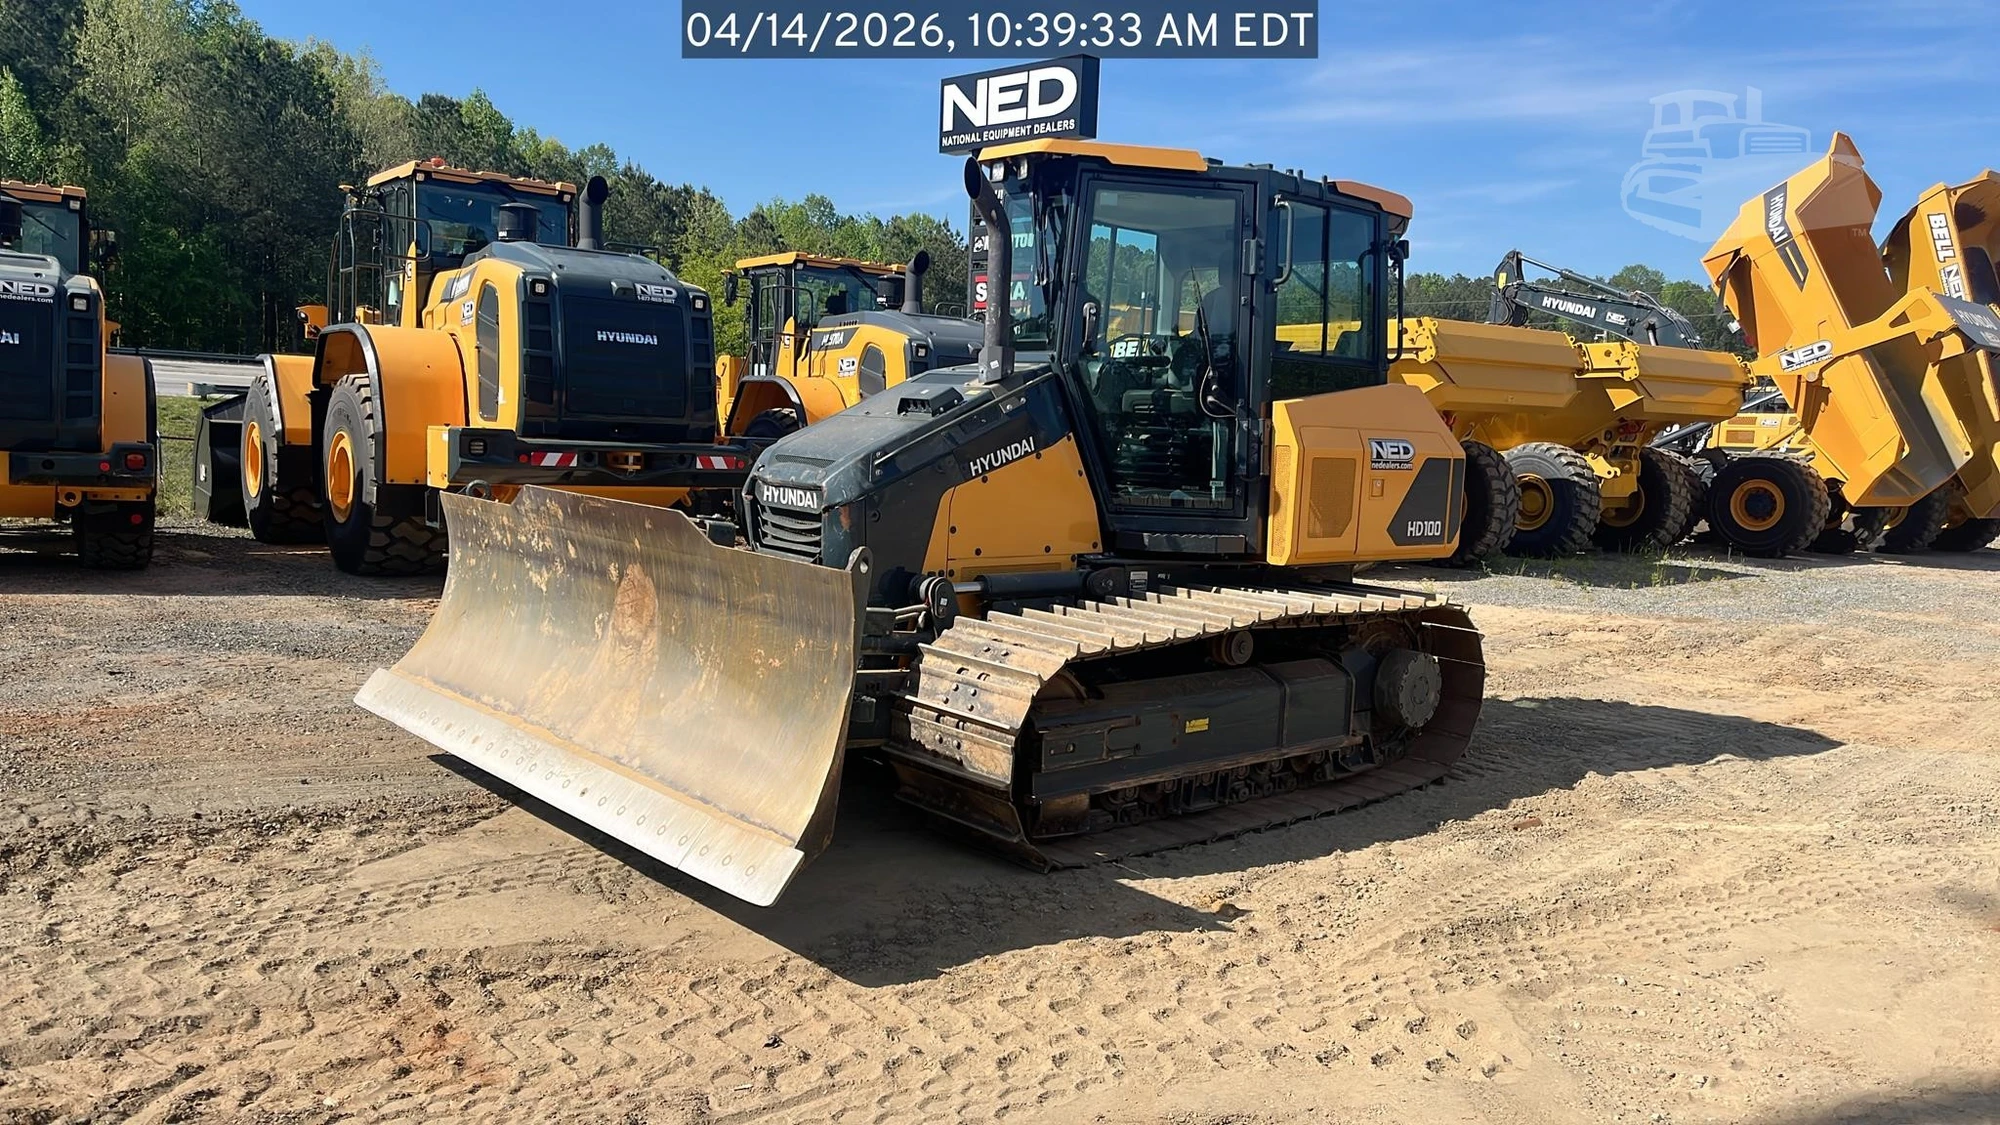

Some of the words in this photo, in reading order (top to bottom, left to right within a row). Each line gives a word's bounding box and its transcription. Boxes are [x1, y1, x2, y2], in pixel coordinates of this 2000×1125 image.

[942, 66, 1078, 132] NED
[942, 132, 981, 147] NATIONAL
[982, 125, 1032, 141] EQUIPMENT
[1033, 118, 1075, 134] DEALERS
[1769, 193, 1788, 243] HYUNDAI
[1928, 213, 1956, 262] BELL
[0, 280, 56, 297] NED
[634, 283, 677, 299] NED
[1542, 296, 1597, 319] HYUNDAI
[597, 330, 658, 346] HYUNDAI
[1780, 341, 1832, 369] NED
[969, 436, 1036, 477] HYUNDAI
[1370, 440, 1415, 460] NED
[1371, 461, 1413, 470] nedealers.com
[763, 485, 818, 510] HYUNDAI
[1407, 520, 1442, 537] HD100
